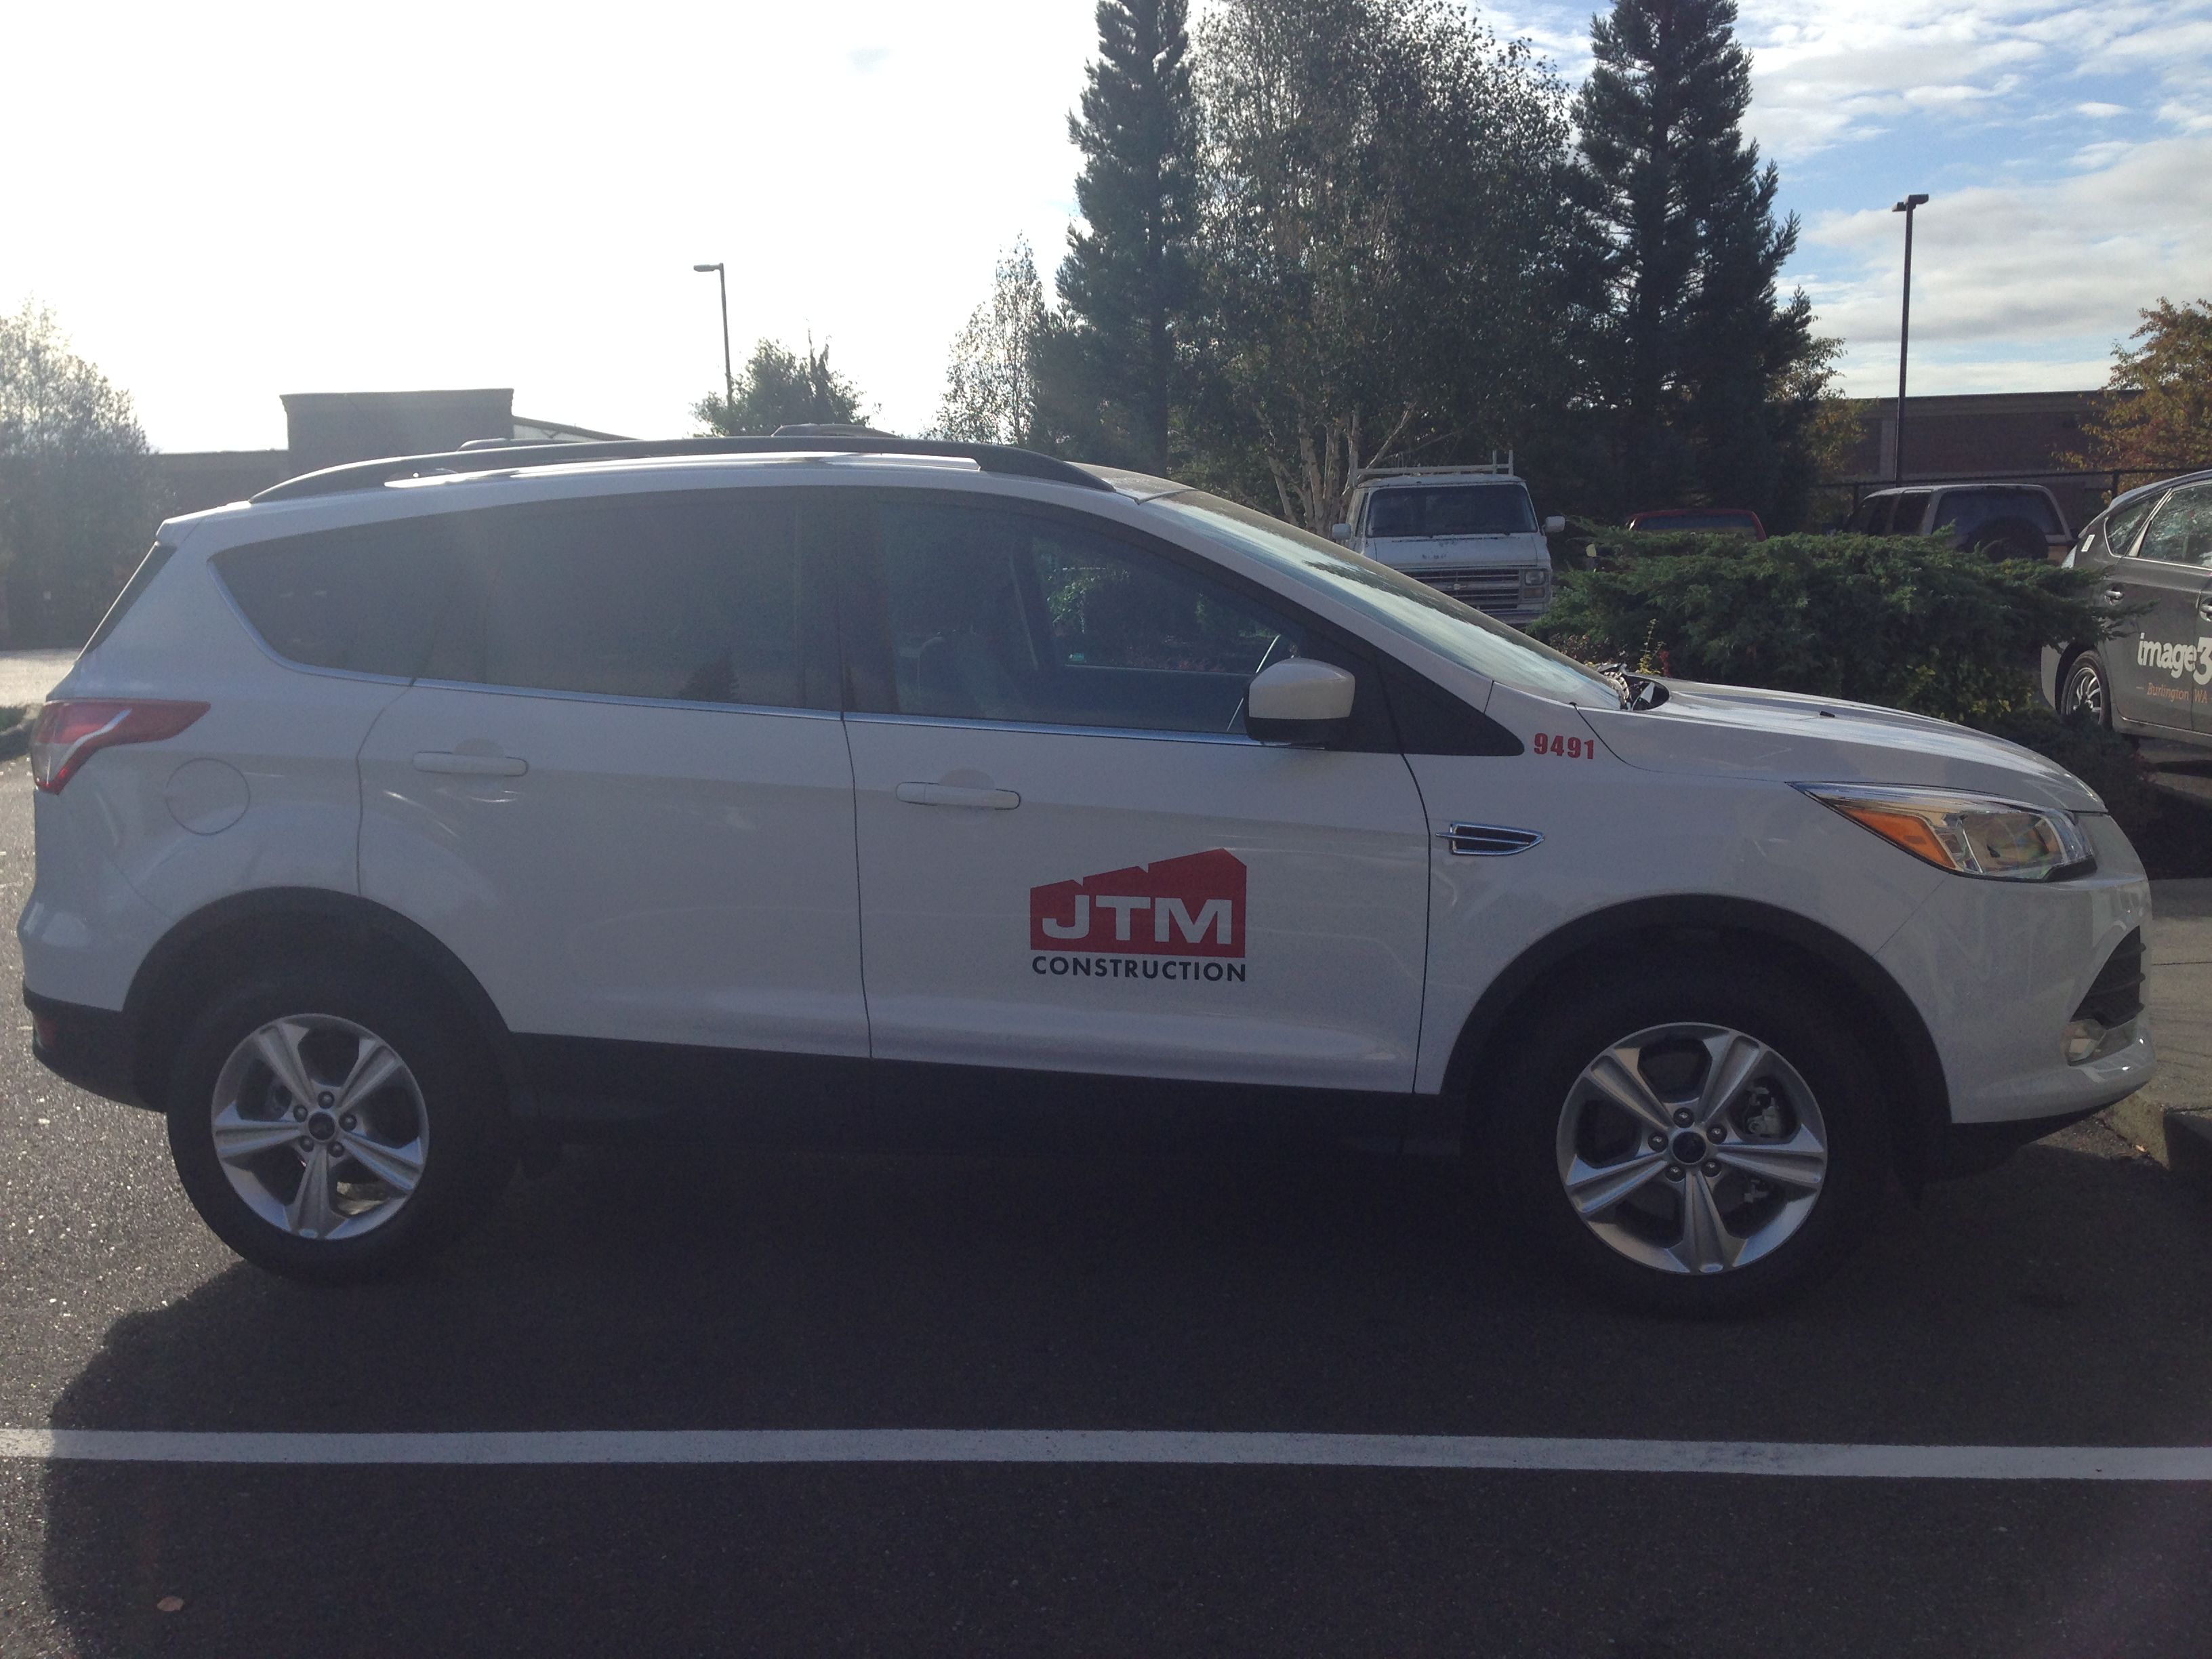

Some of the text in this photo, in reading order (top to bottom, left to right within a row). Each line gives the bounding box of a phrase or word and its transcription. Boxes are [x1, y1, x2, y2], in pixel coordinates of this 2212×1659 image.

[2147, 683, 2208, 703] Burlington WA
[1534, 733, 1595, 759] 9491
[1042, 895, 1233, 944] JTM
[1032, 956, 1246, 982] CONSTRUCTION
